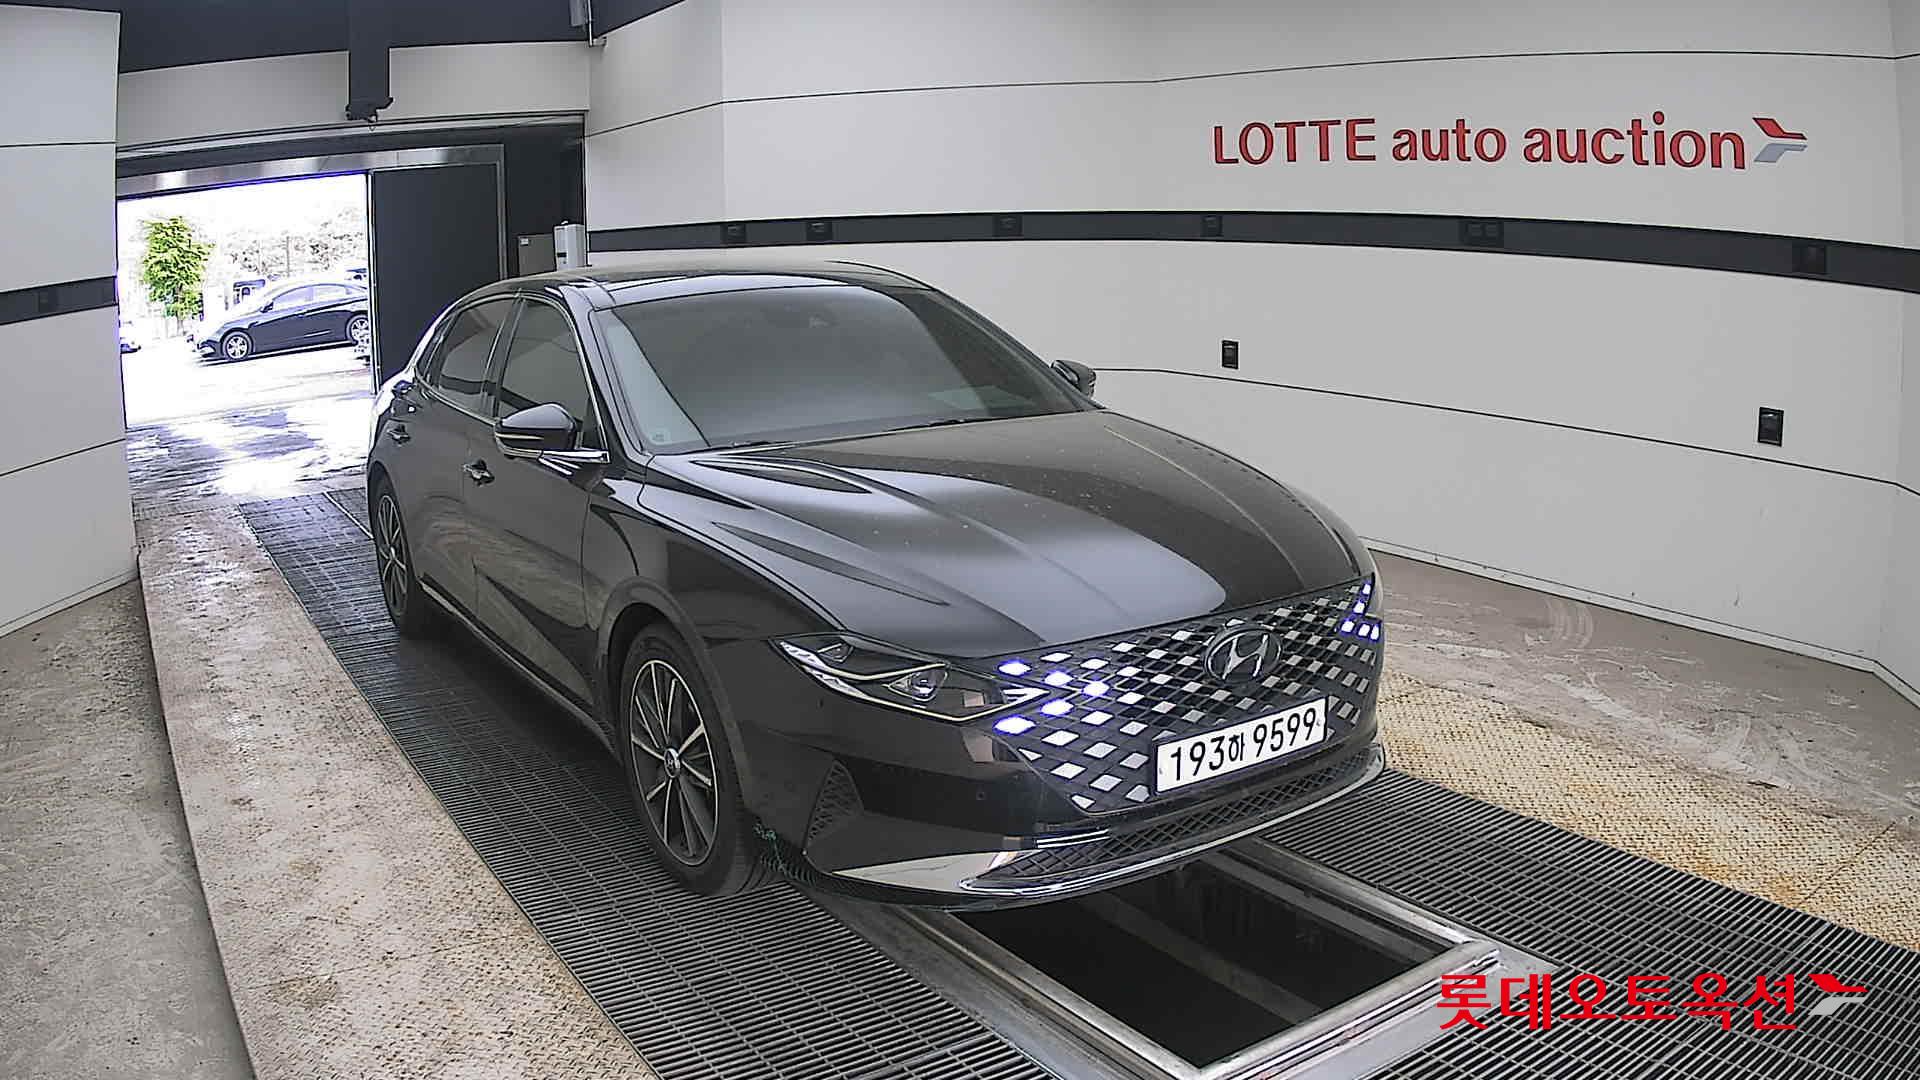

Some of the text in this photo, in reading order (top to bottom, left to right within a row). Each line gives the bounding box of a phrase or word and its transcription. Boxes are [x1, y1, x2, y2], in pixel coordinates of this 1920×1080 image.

[1212, 110, 1746, 170] LOTTE auto auction
[1170, 707, 1317, 782] 193하 9599
